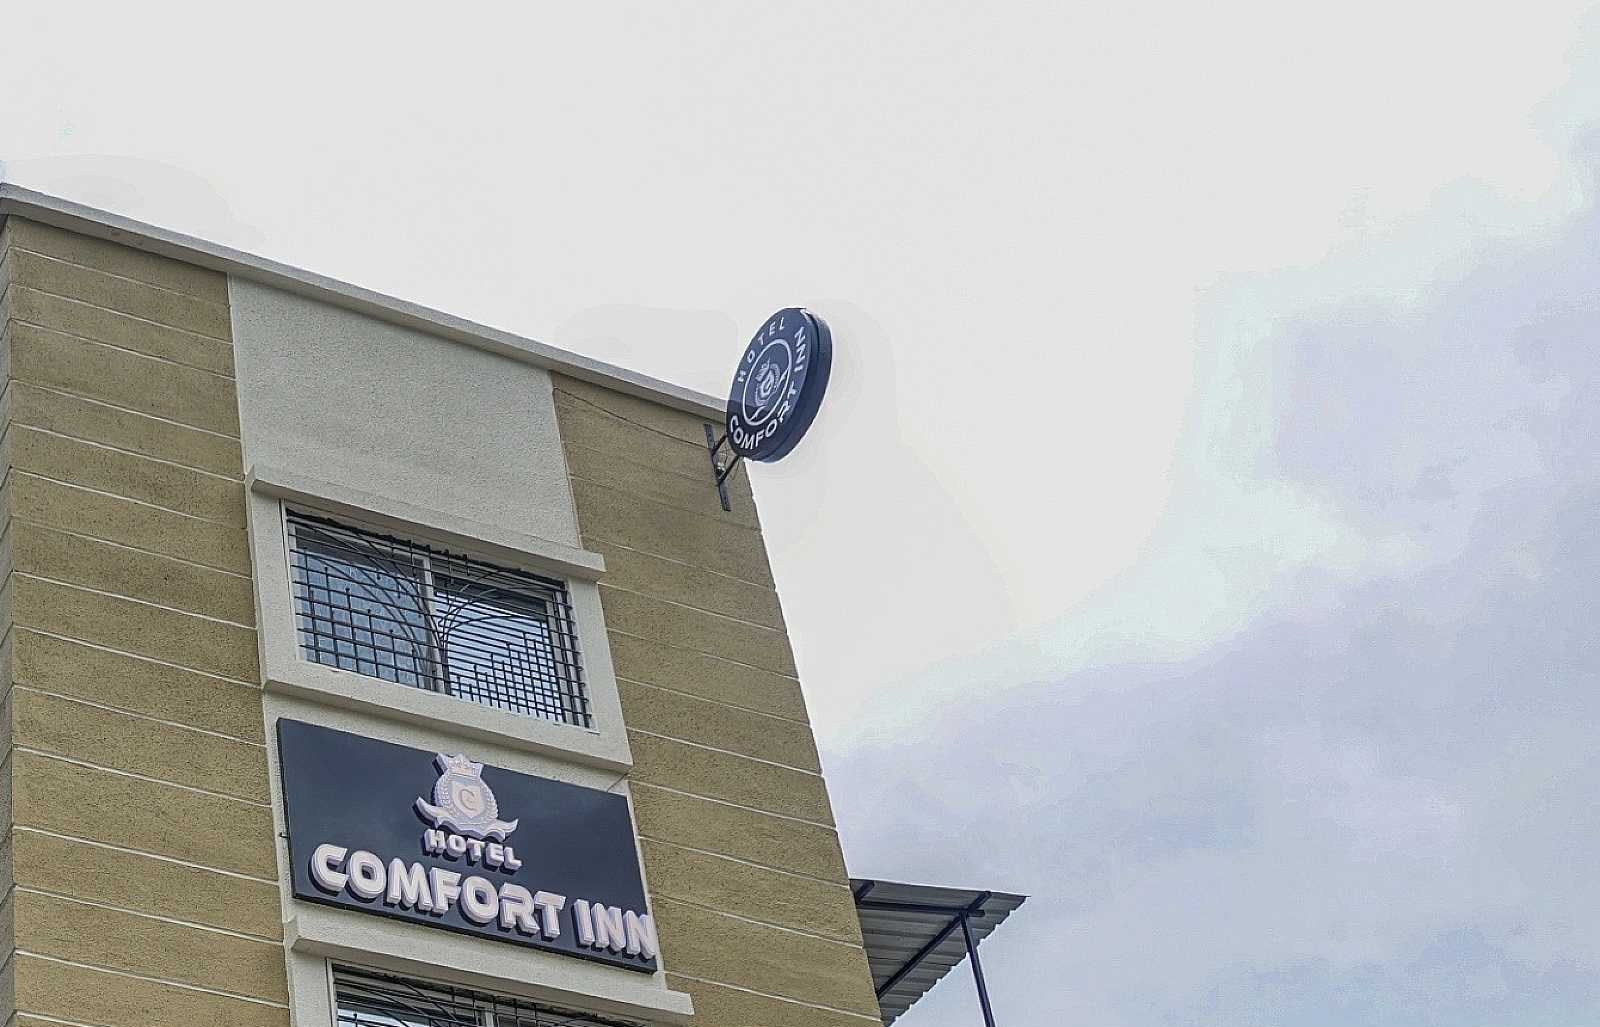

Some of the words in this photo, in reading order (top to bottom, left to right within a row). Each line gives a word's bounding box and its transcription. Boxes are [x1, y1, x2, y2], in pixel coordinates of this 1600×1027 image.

[729, 379, 798, 451] COMFORT
[794, 326, 805, 372] INN
[738, 316, 785, 383] HOTEL
[424, 828, 522, 870] HOTEL
[311, 842, 567, 939] COMFORT
[572, 898, 657, 960] INN
